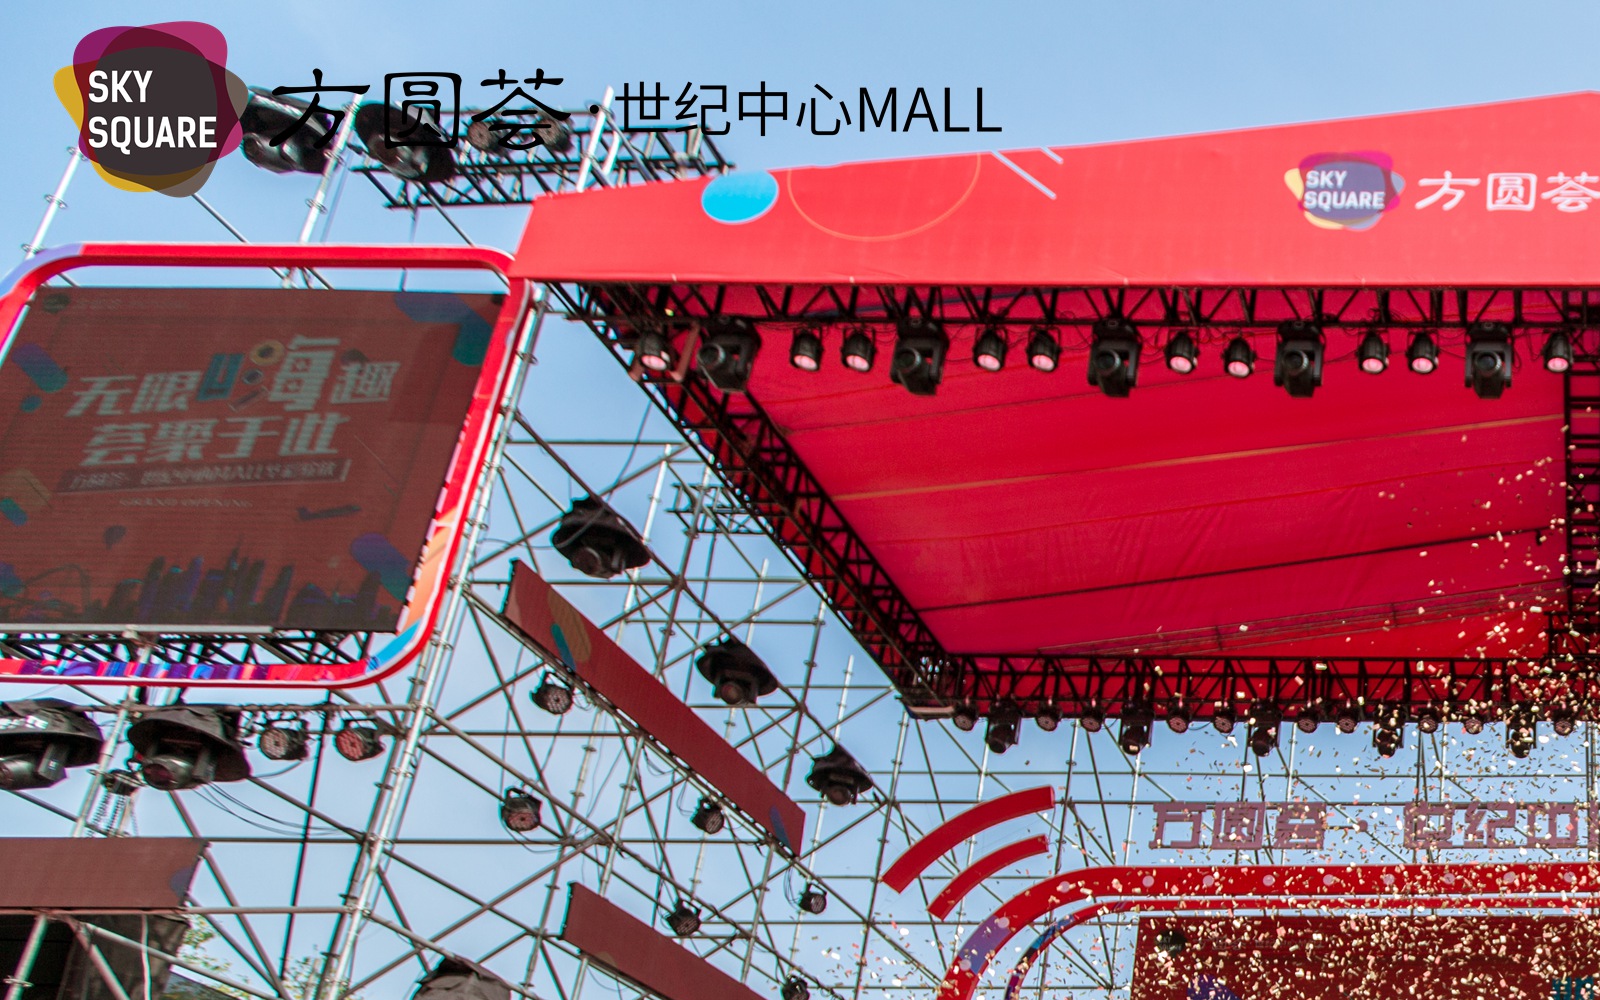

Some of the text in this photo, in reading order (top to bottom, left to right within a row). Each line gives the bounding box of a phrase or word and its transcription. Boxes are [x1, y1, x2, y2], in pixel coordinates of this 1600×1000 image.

[1305, 170, 1347, 189] SKY
[1303, 190, 1385, 211] SQUARE
[80, 412, 351, 467] 荟聚于此
